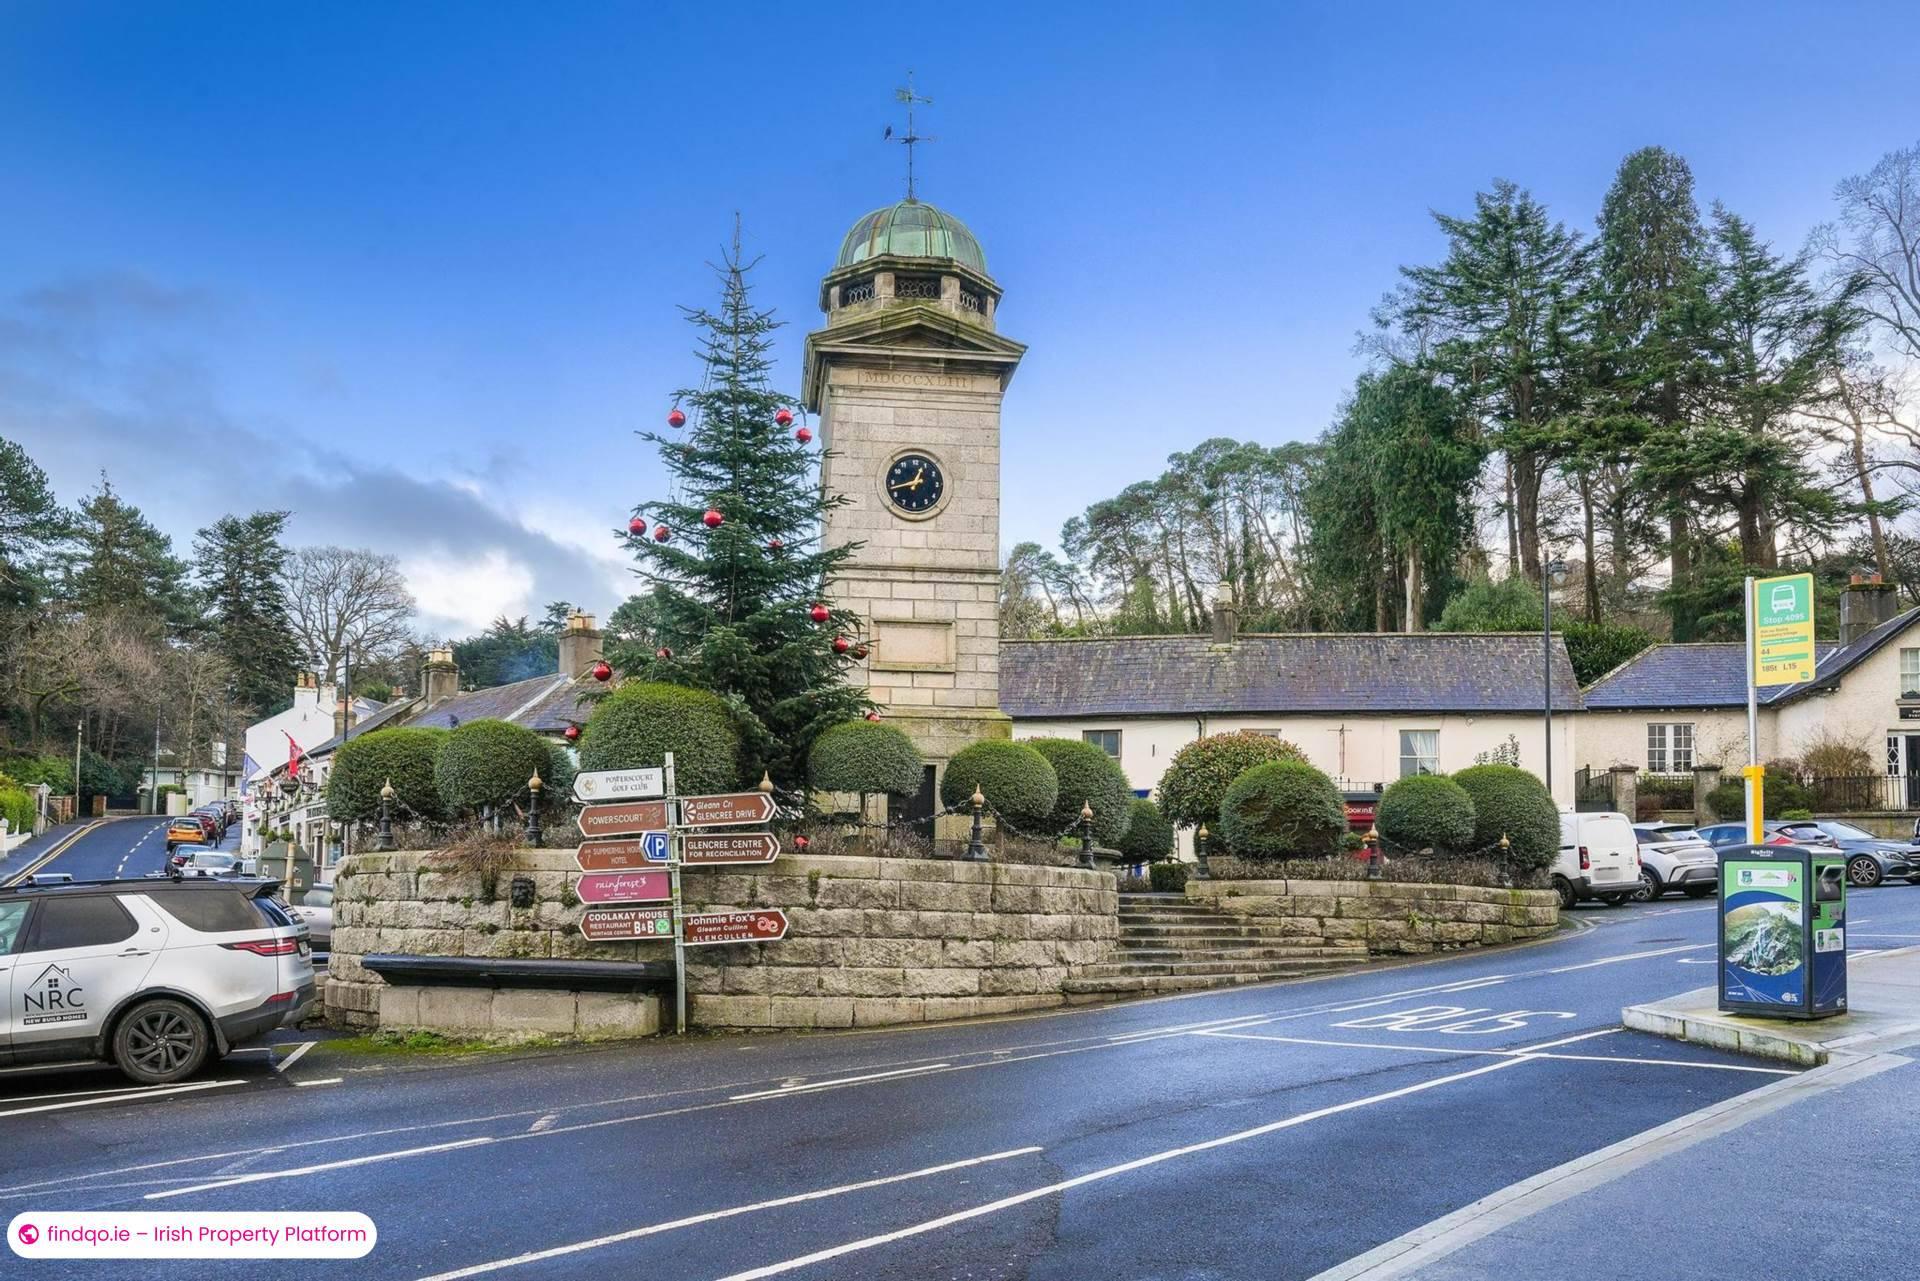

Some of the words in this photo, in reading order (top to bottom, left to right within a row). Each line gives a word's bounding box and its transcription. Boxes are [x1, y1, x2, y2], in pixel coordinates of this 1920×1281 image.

[1763, 616, 1783, 625] Stop
[605, 774, 654, 783] POWERSCOURT
[611, 785, 628, 793] GOLF
[630, 783, 648, 791] CLUB
[696, 801, 720, 810] Gleann
[587, 814, 643, 824] POWERSCOURT
[696, 811, 733, 820] GLENCREE
[735, 809, 757, 818] DRIVE
[655, 838, 664, 856] P
[687, 841, 729, 850] GLENCREE
[731, 839, 763, 848] CENTRE
[705, 849, 762, 857] RECONCILIATION
[610, 856, 628, 865] HOTEL
[595, 876, 643, 892] rainforest
[588, 912, 636, 921] COOLAKAY
[638, 910, 669, 919] HOUSE
[687, 916, 727, 926] Johnnie
[729, 913, 756, 923] Fox's
[633, 920, 654, 934] B&B
[692, 932, 754, 942] GLENCULLEN
[24, 988, 84, 1012] NRC
[42, 1015, 62, 1023] BUILD
[63, 1013, 86, 1021] HOMES
[1329, 1006, 1577, 1034] BUS
